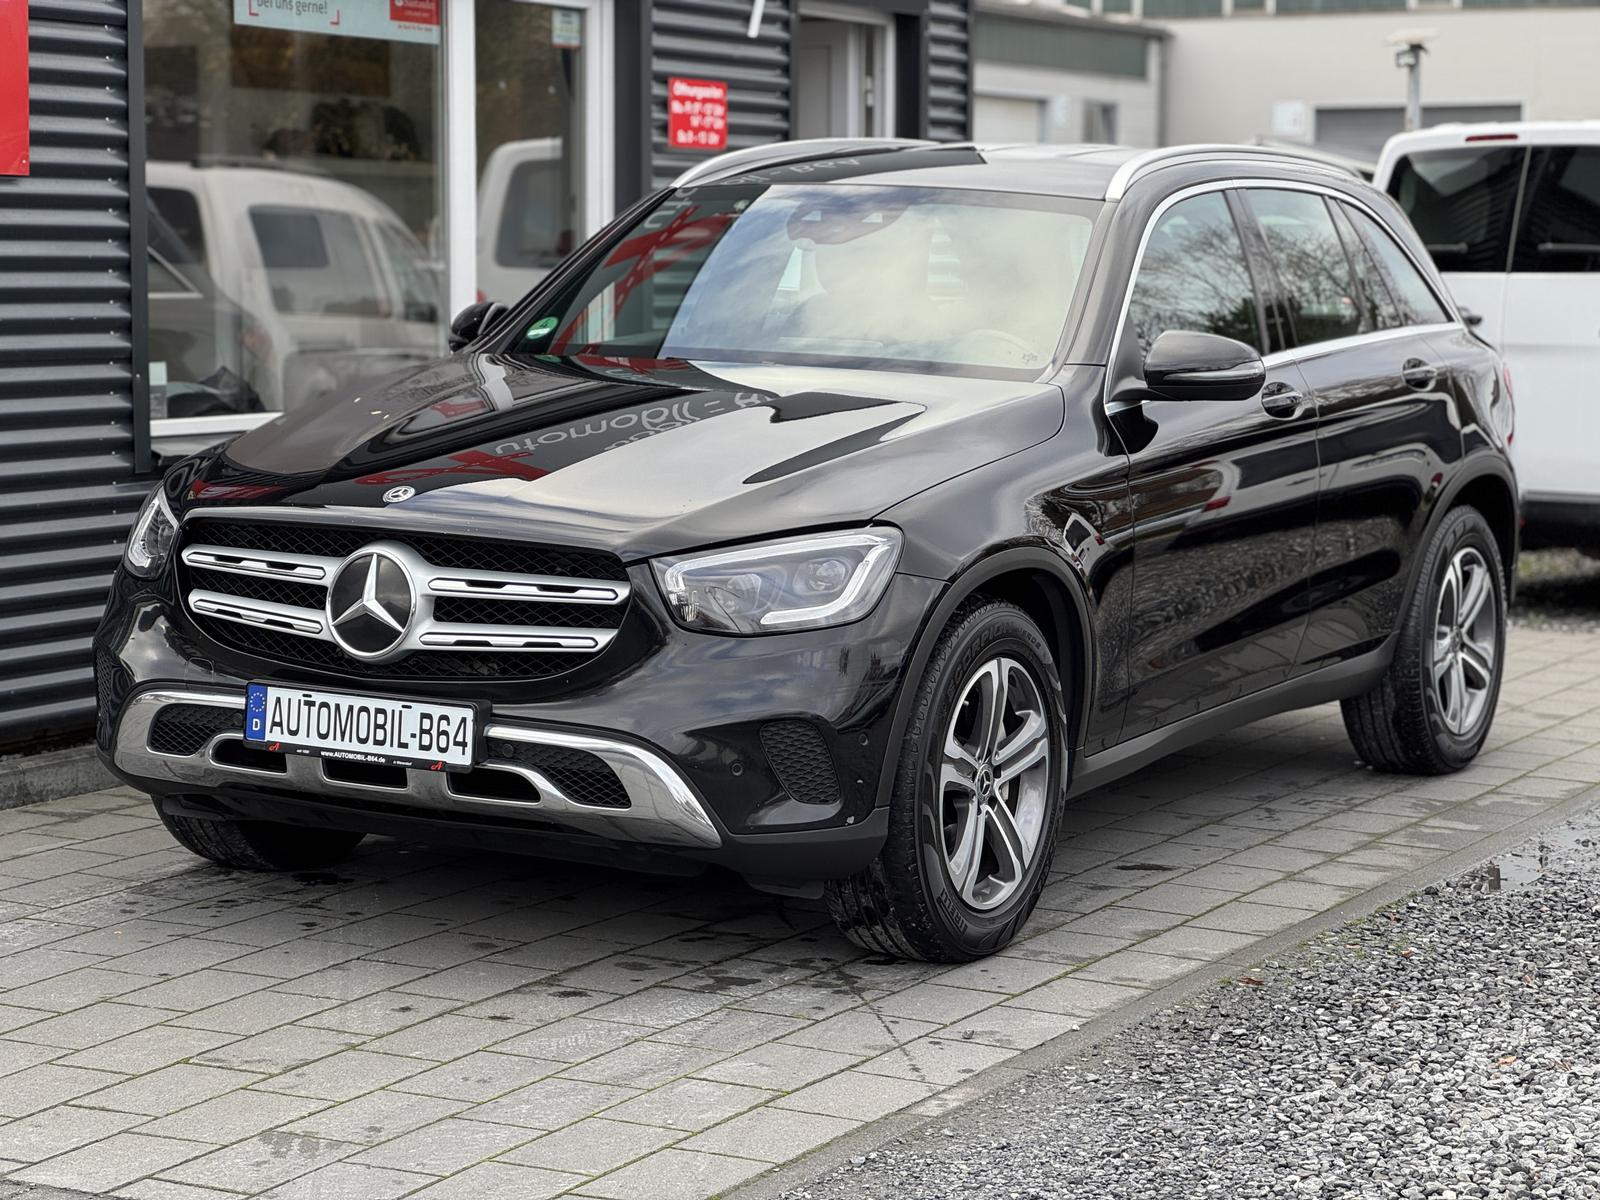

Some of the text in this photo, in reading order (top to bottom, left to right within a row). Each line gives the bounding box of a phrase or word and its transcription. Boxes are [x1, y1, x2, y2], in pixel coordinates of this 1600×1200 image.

[275, 0, 294, 11] uns
[295, 1, 328, 16] gerne!
[252, 718, 261, 731] D
[269, 696, 468, 756] AUTOMOBIL-B64
[320, 750, 386, 764] www.AUTOMOBIL-B64.de
